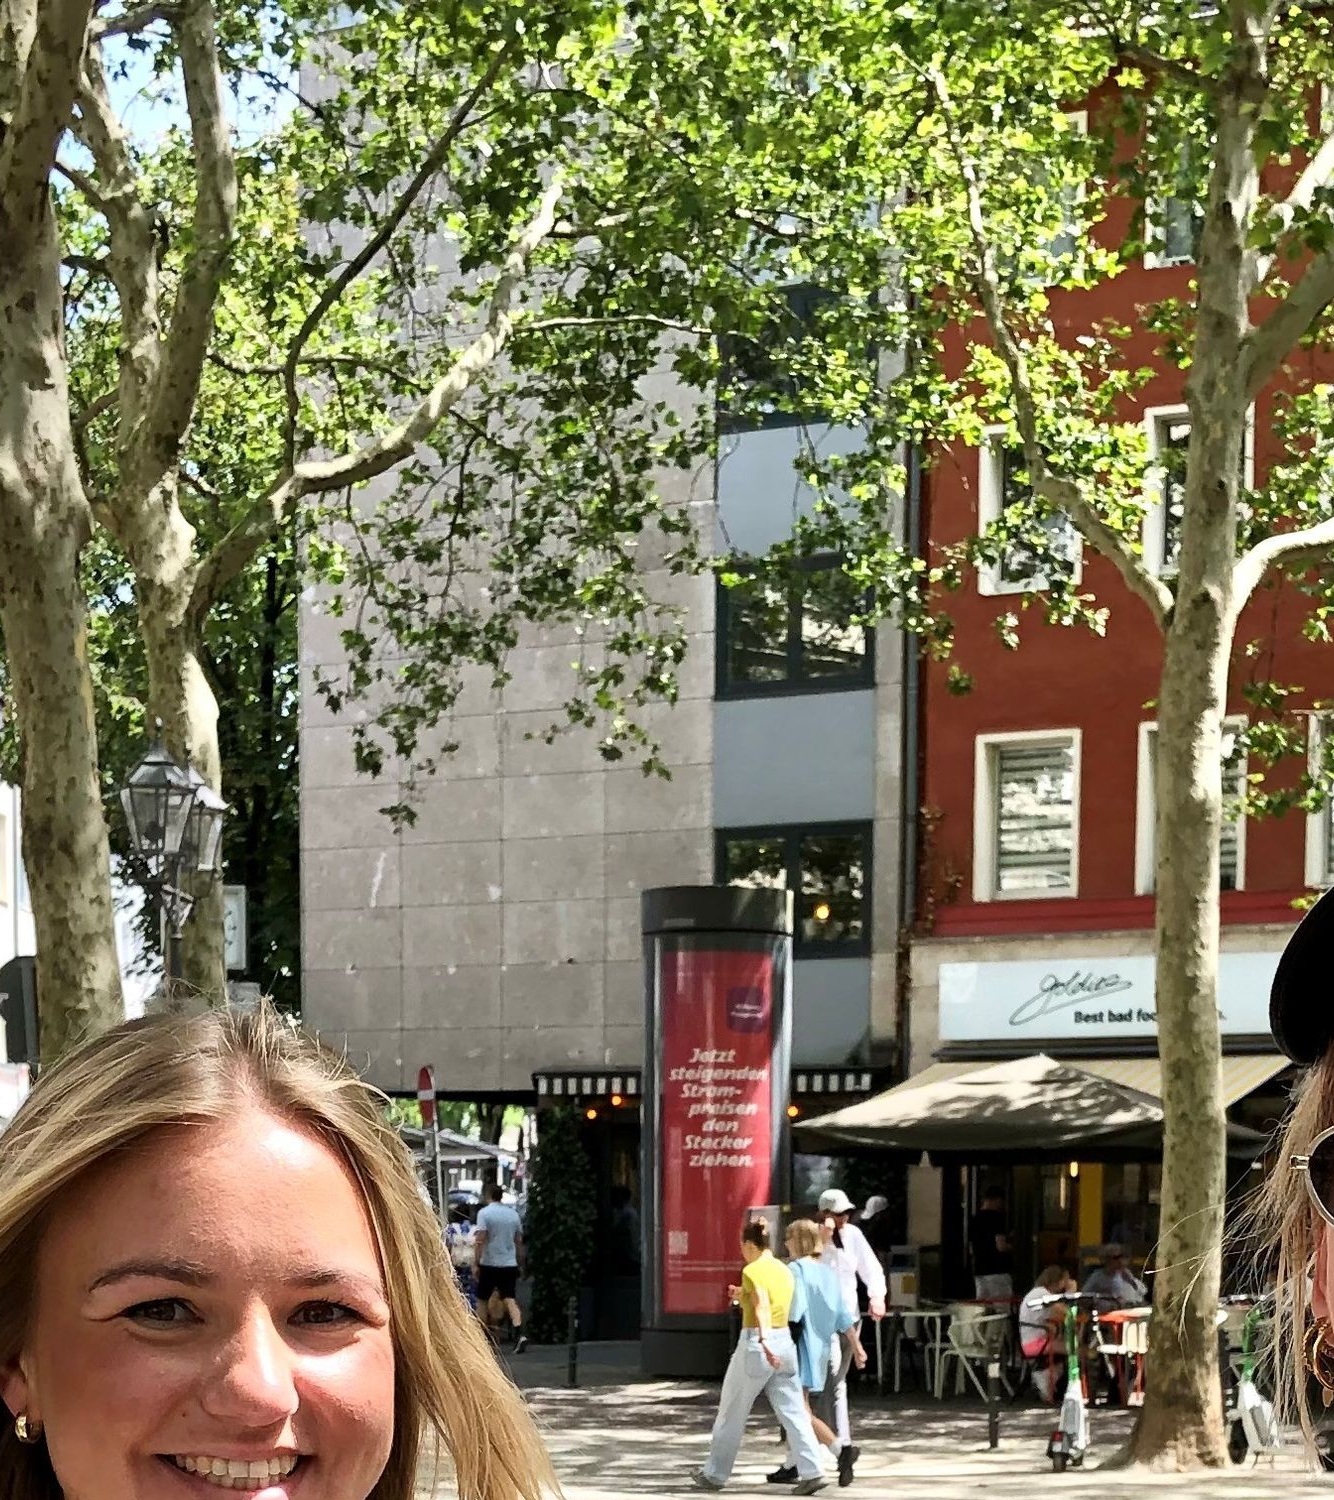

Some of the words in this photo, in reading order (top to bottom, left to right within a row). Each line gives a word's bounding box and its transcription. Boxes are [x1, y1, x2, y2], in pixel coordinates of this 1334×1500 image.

[1073, 1010, 1104, 1023] Best
[1108, 1008, 1133, 1022] bad
[689, 1047, 737, 1063] Jetzt
[669, 1065, 768, 1083] steigenden
[688, 1101, 759, 1118] preisen
[702, 1117, 739, 1132] den
[683, 1134, 754, 1150] Stecker
